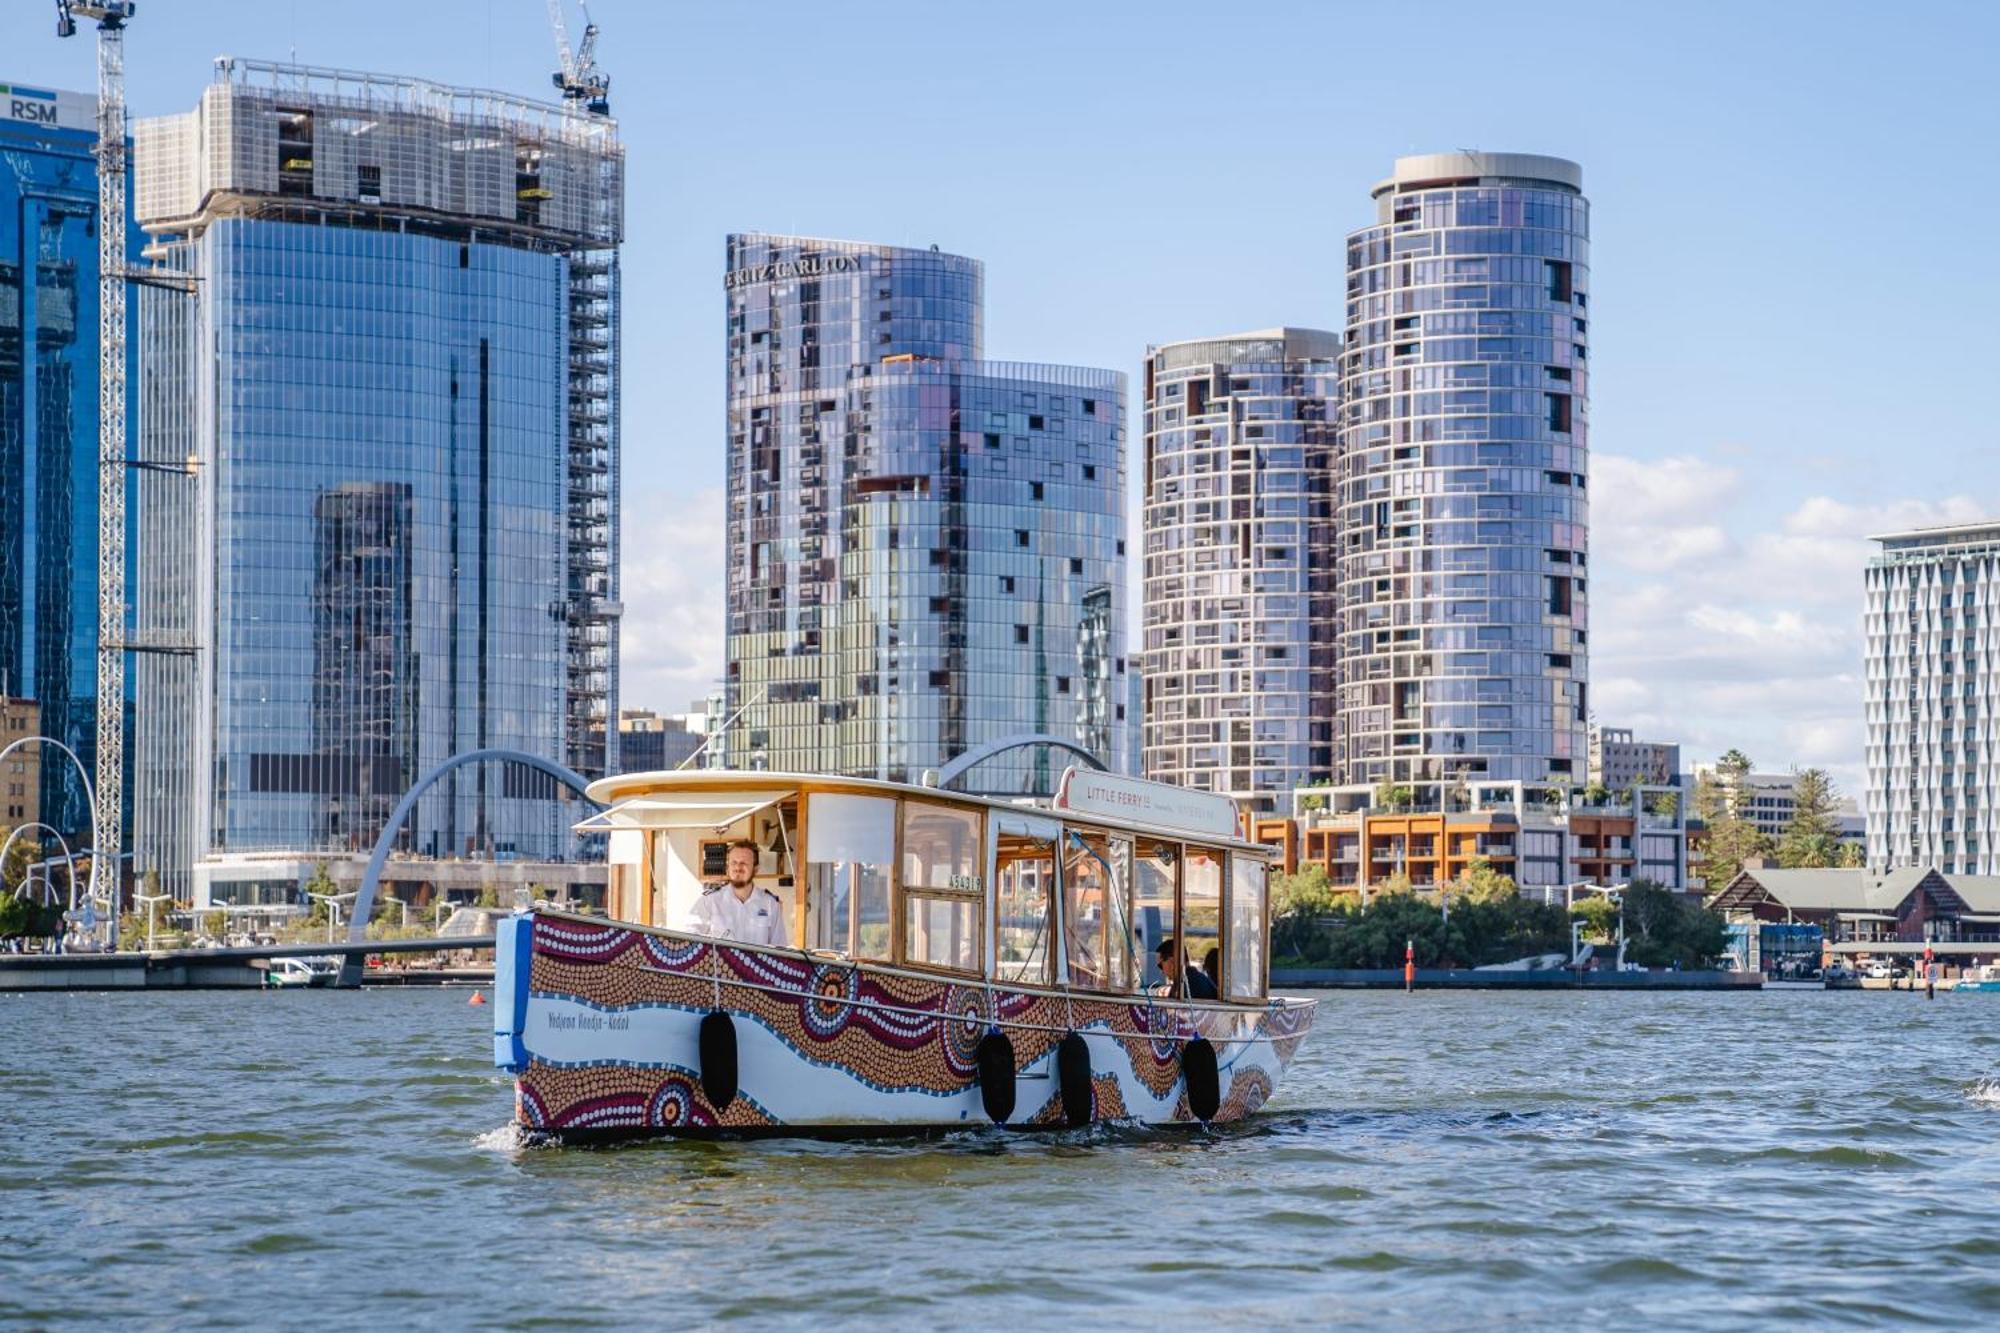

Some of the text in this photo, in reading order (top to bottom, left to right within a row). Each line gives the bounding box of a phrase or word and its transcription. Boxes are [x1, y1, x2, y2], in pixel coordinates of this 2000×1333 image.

[11, 99, 57, 124] RSM
[1087, 786, 1115, 803] LITTLE
[1118, 792, 1141, 808] FERRY
